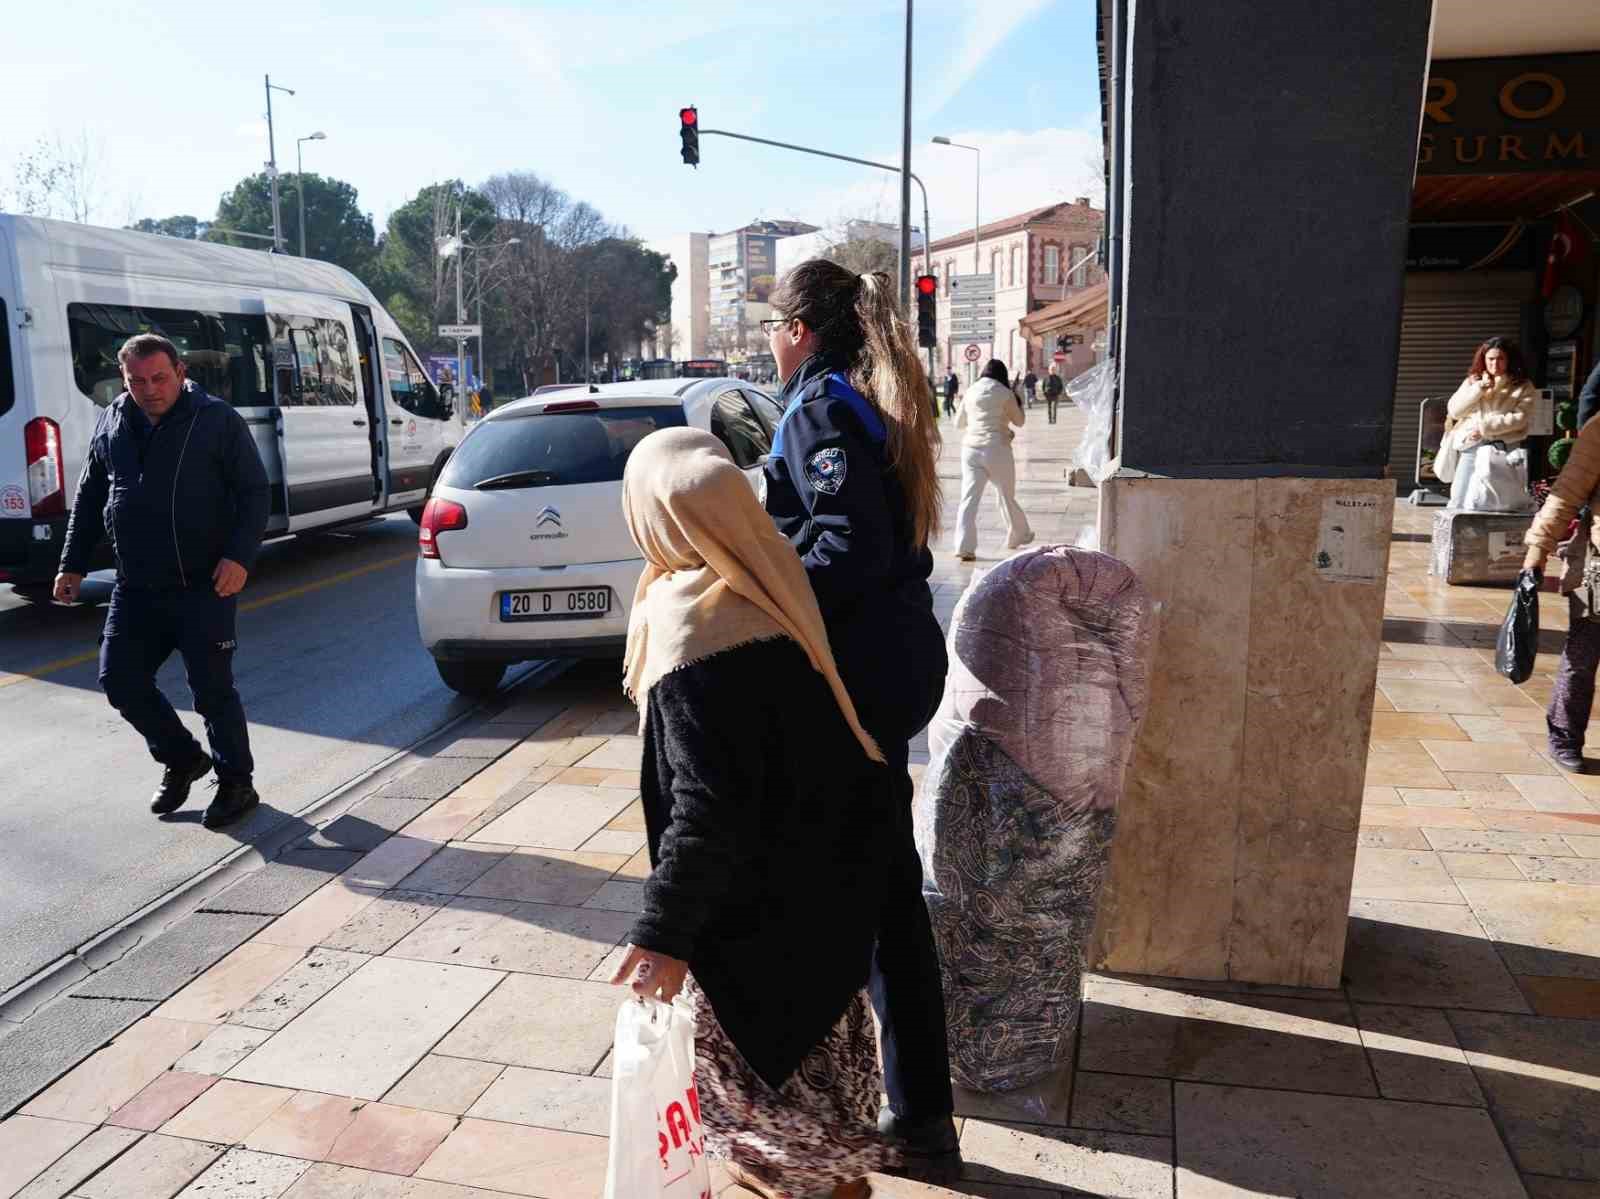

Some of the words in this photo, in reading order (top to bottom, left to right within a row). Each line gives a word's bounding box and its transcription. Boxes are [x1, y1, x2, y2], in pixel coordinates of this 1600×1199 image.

[4, 497, 25, 510] 153
[512, 594, 530, 613] 20
[543, 594, 552, 612] D
[567, 591, 606, 611] 0580
